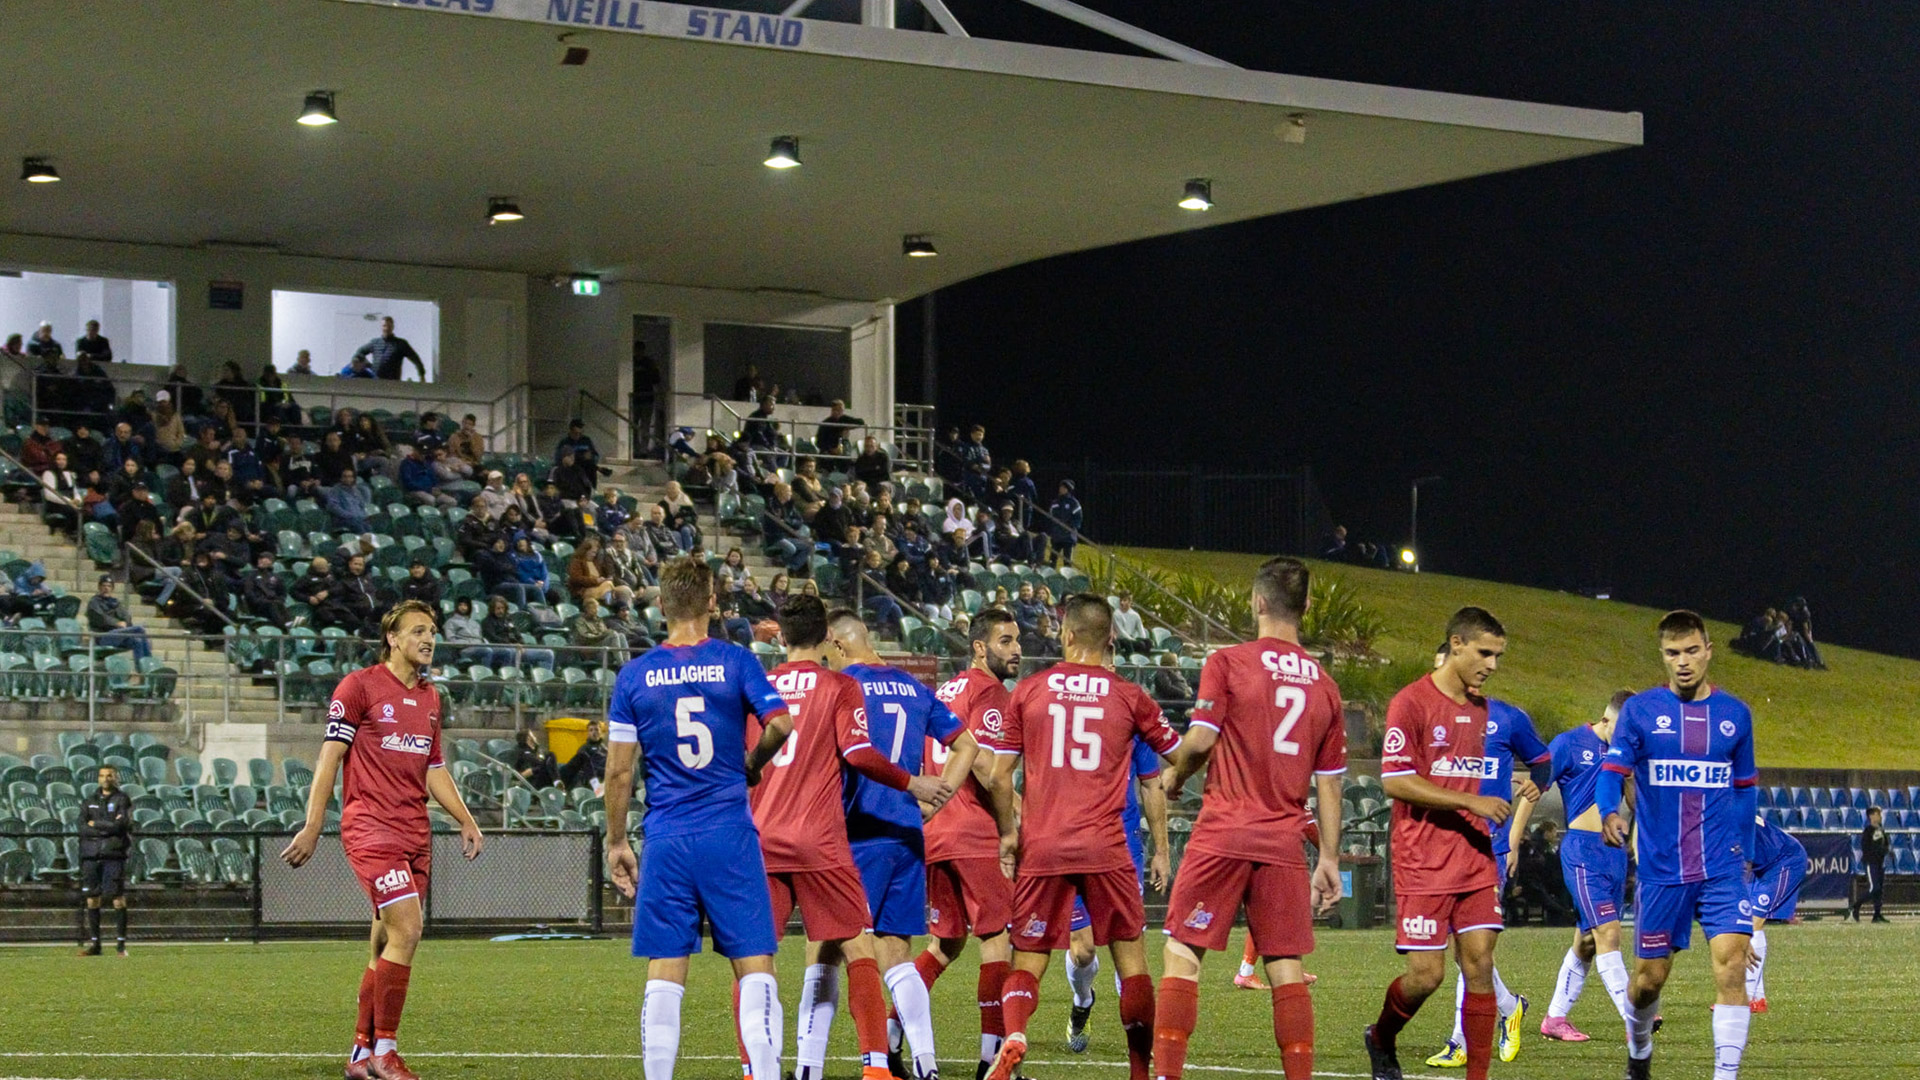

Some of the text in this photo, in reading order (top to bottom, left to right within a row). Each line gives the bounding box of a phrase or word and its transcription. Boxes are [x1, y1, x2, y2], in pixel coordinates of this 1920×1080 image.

[546, 0, 804, 47] NEILL STAND
[645, 665, 726, 688] GALLAGHER
[1261, 651, 1320, 681] cdn
[863, 681, 918, 698] FULTON
[1047, 673, 1110, 697] cdn
[675, 696, 714, 770] 5
[882, 702, 907, 764] 7
[1273, 685, 1306, 756] 2
[1048, 703, 1105, 772] 15
[1655, 764, 1730, 784] BING LEE
[375, 869, 410, 892] cdn
[1402, 915, 1437, 935] cdn
